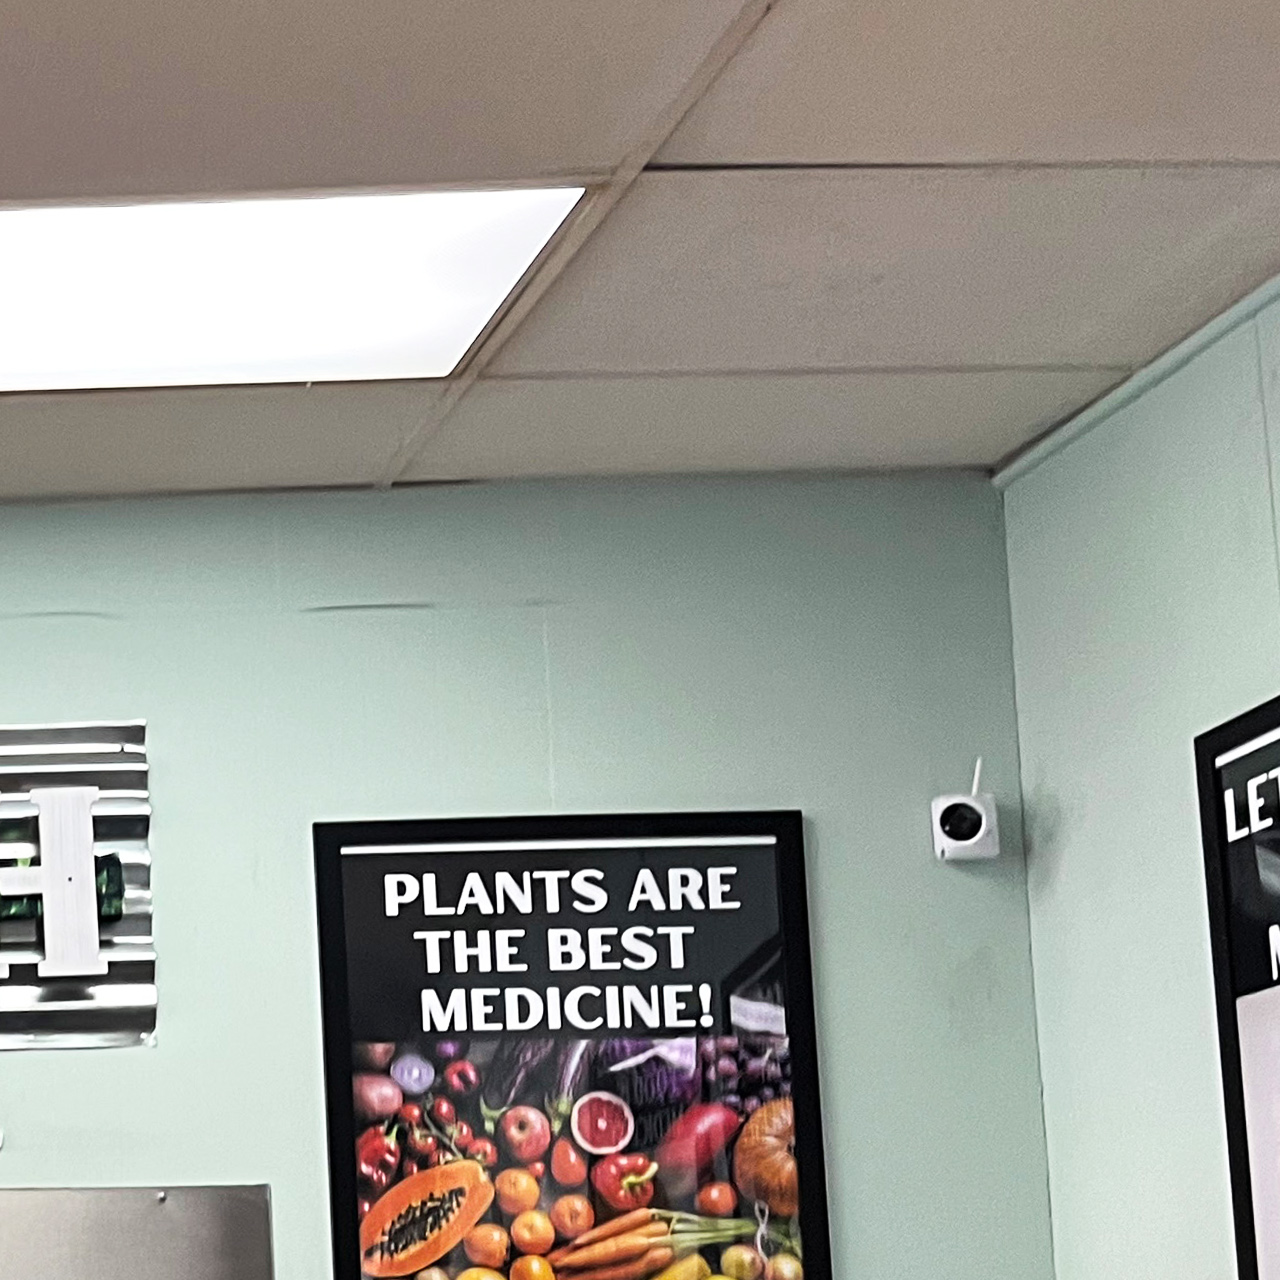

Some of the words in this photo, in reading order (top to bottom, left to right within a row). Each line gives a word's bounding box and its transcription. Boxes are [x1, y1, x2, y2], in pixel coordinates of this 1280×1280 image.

[383, 868, 608, 917] PLANTS
[628, 866, 741, 912] ARE
[413, 928, 528, 974] THE
[547, 925, 695, 971] BEST
[420, 983, 714, 1033] MEDICINE!
